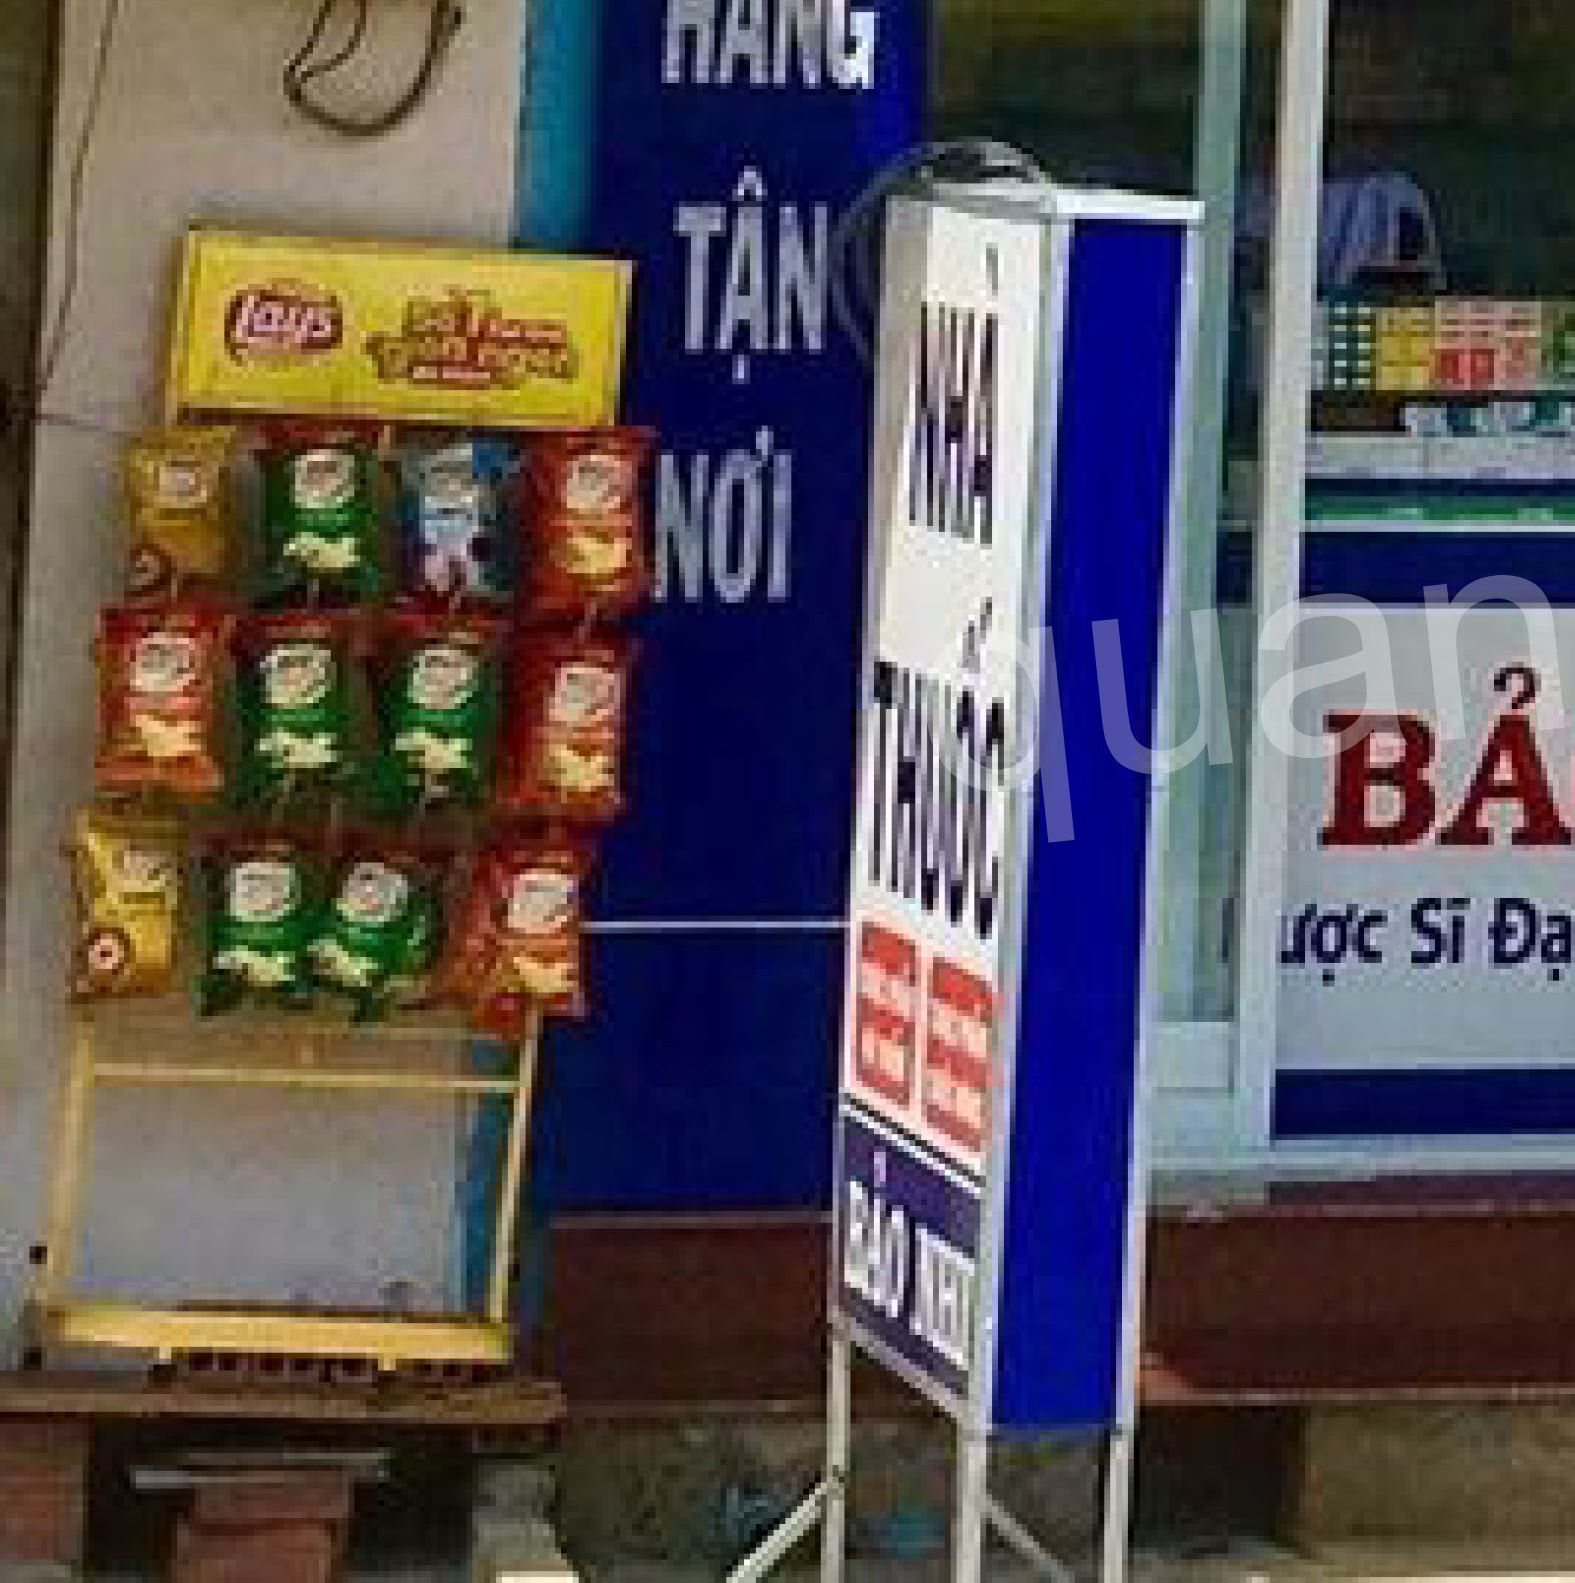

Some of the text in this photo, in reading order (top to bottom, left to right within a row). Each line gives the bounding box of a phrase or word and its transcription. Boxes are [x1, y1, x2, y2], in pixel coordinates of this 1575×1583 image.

[673, 166, 830, 385] TẬN
[907, 246, 1000, 546] NHÀ
[650, 425, 794, 605] NƠI
[869, 596, 1006, 942] THUỐC
[1279, 901, 1385, 986] ược
[1408, 895, 1466, 968] Sĩ
